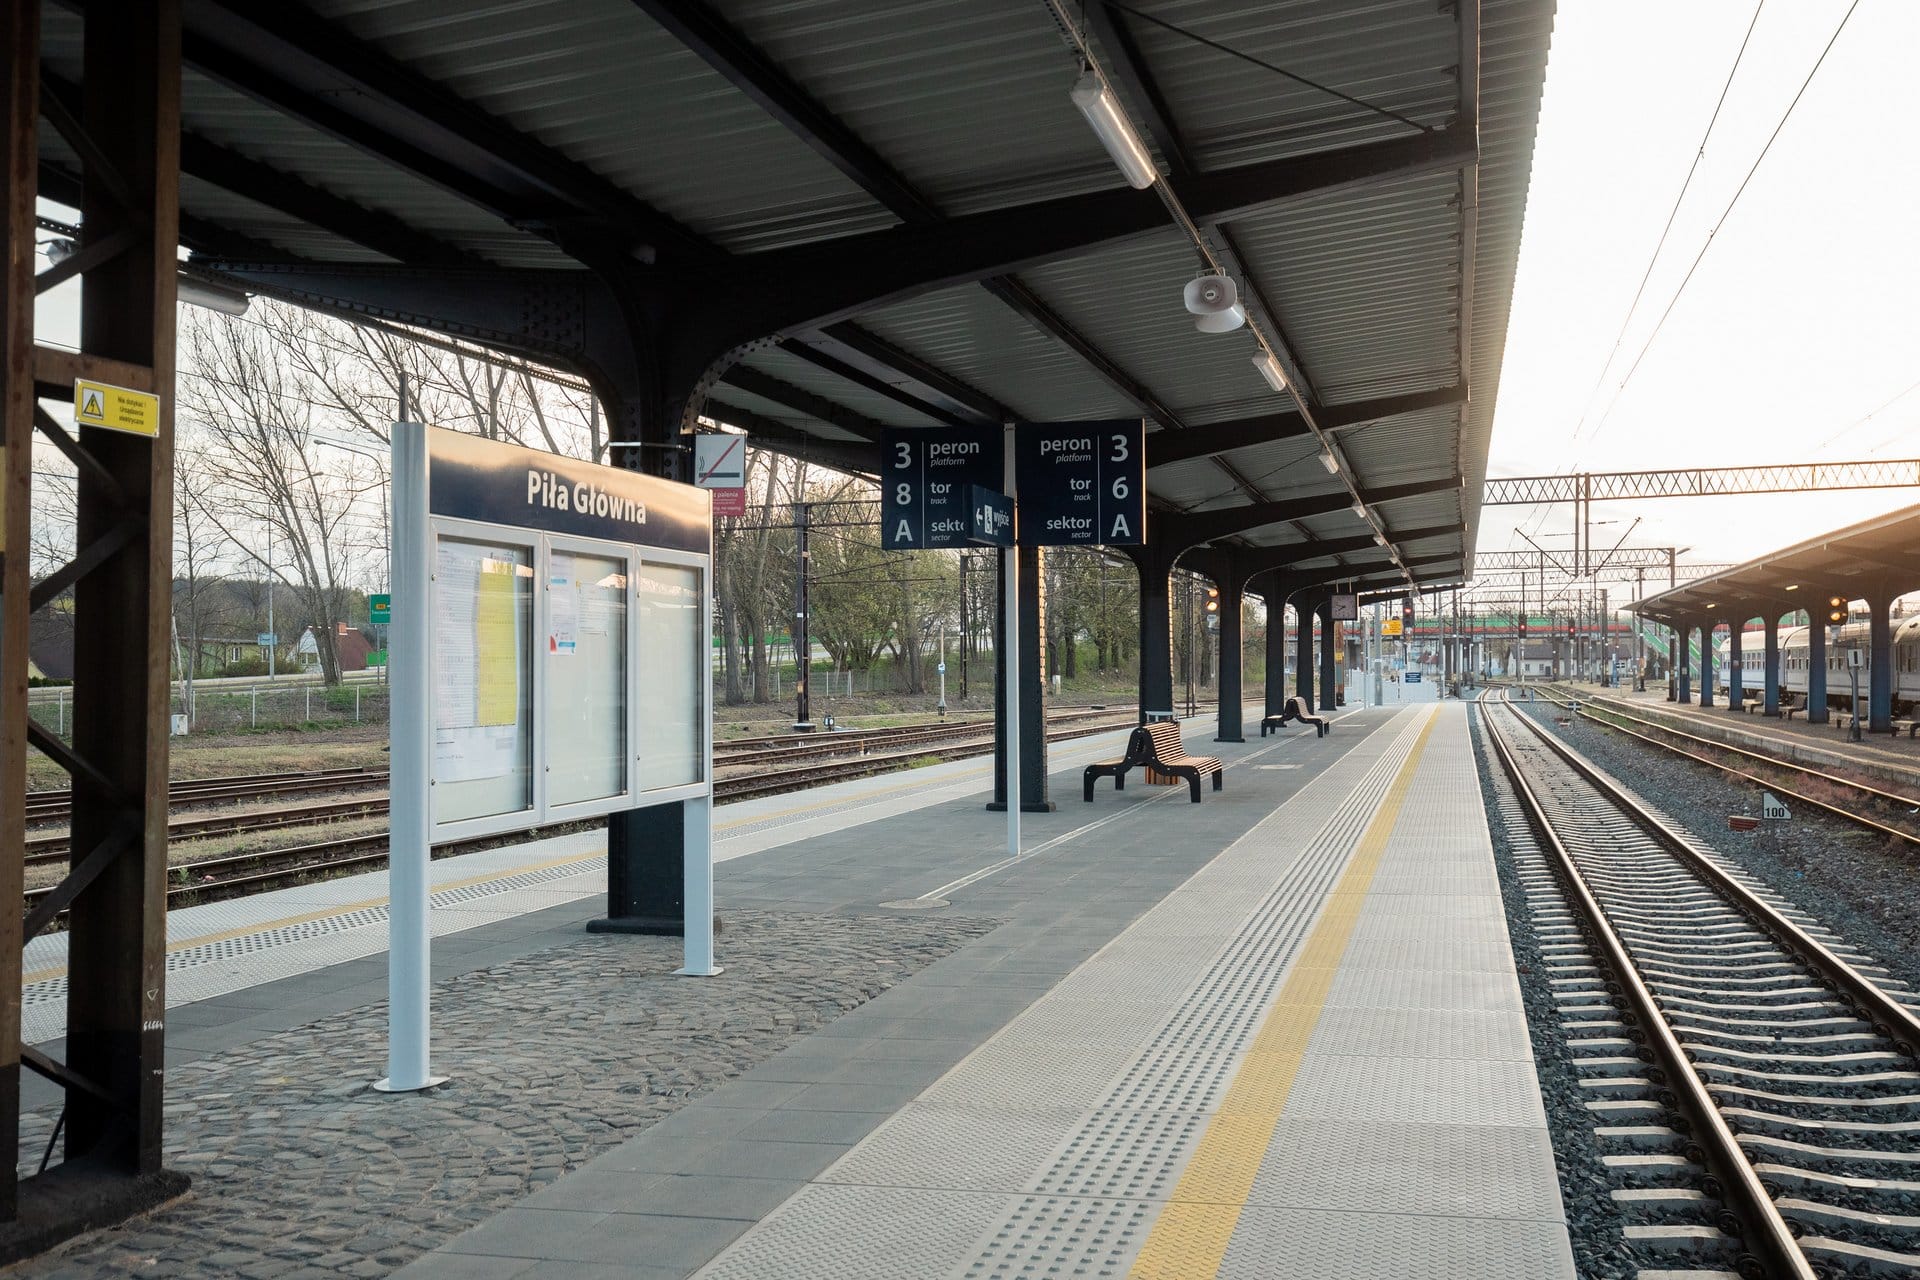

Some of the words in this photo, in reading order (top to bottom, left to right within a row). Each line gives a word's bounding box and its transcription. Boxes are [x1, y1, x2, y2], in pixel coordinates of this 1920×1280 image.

[894, 442, 912, 469] 3
[929, 442, 980, 459] peron
[1040, 438, 1092, 456] peron
[1110, 434, 1129, 462] 3
[1056, 453, 1092, 464] platform
[930, 456, 966, 468] platform
[527, 470, 569, 511] Piła
[573, 481, 647, 525] Główna
[896, 482, 912, 506] 8
[930, 481, 952, 494] tor
[1069, 478, 1092, 491] tor
[1112, 476, 1129, 500] 6
[1073, 493, 1092, 501] track
[930, 496, 948, 505] track
[894, 519, 913, 543] A
[931, 518, 965, 532] sekt
[1046, 515, 1092, 530] sektor
[1110, 513, 1131, 538] A
[1071, 531, 1092, 539] sector
[1765, 807, 1785, 818] 100
